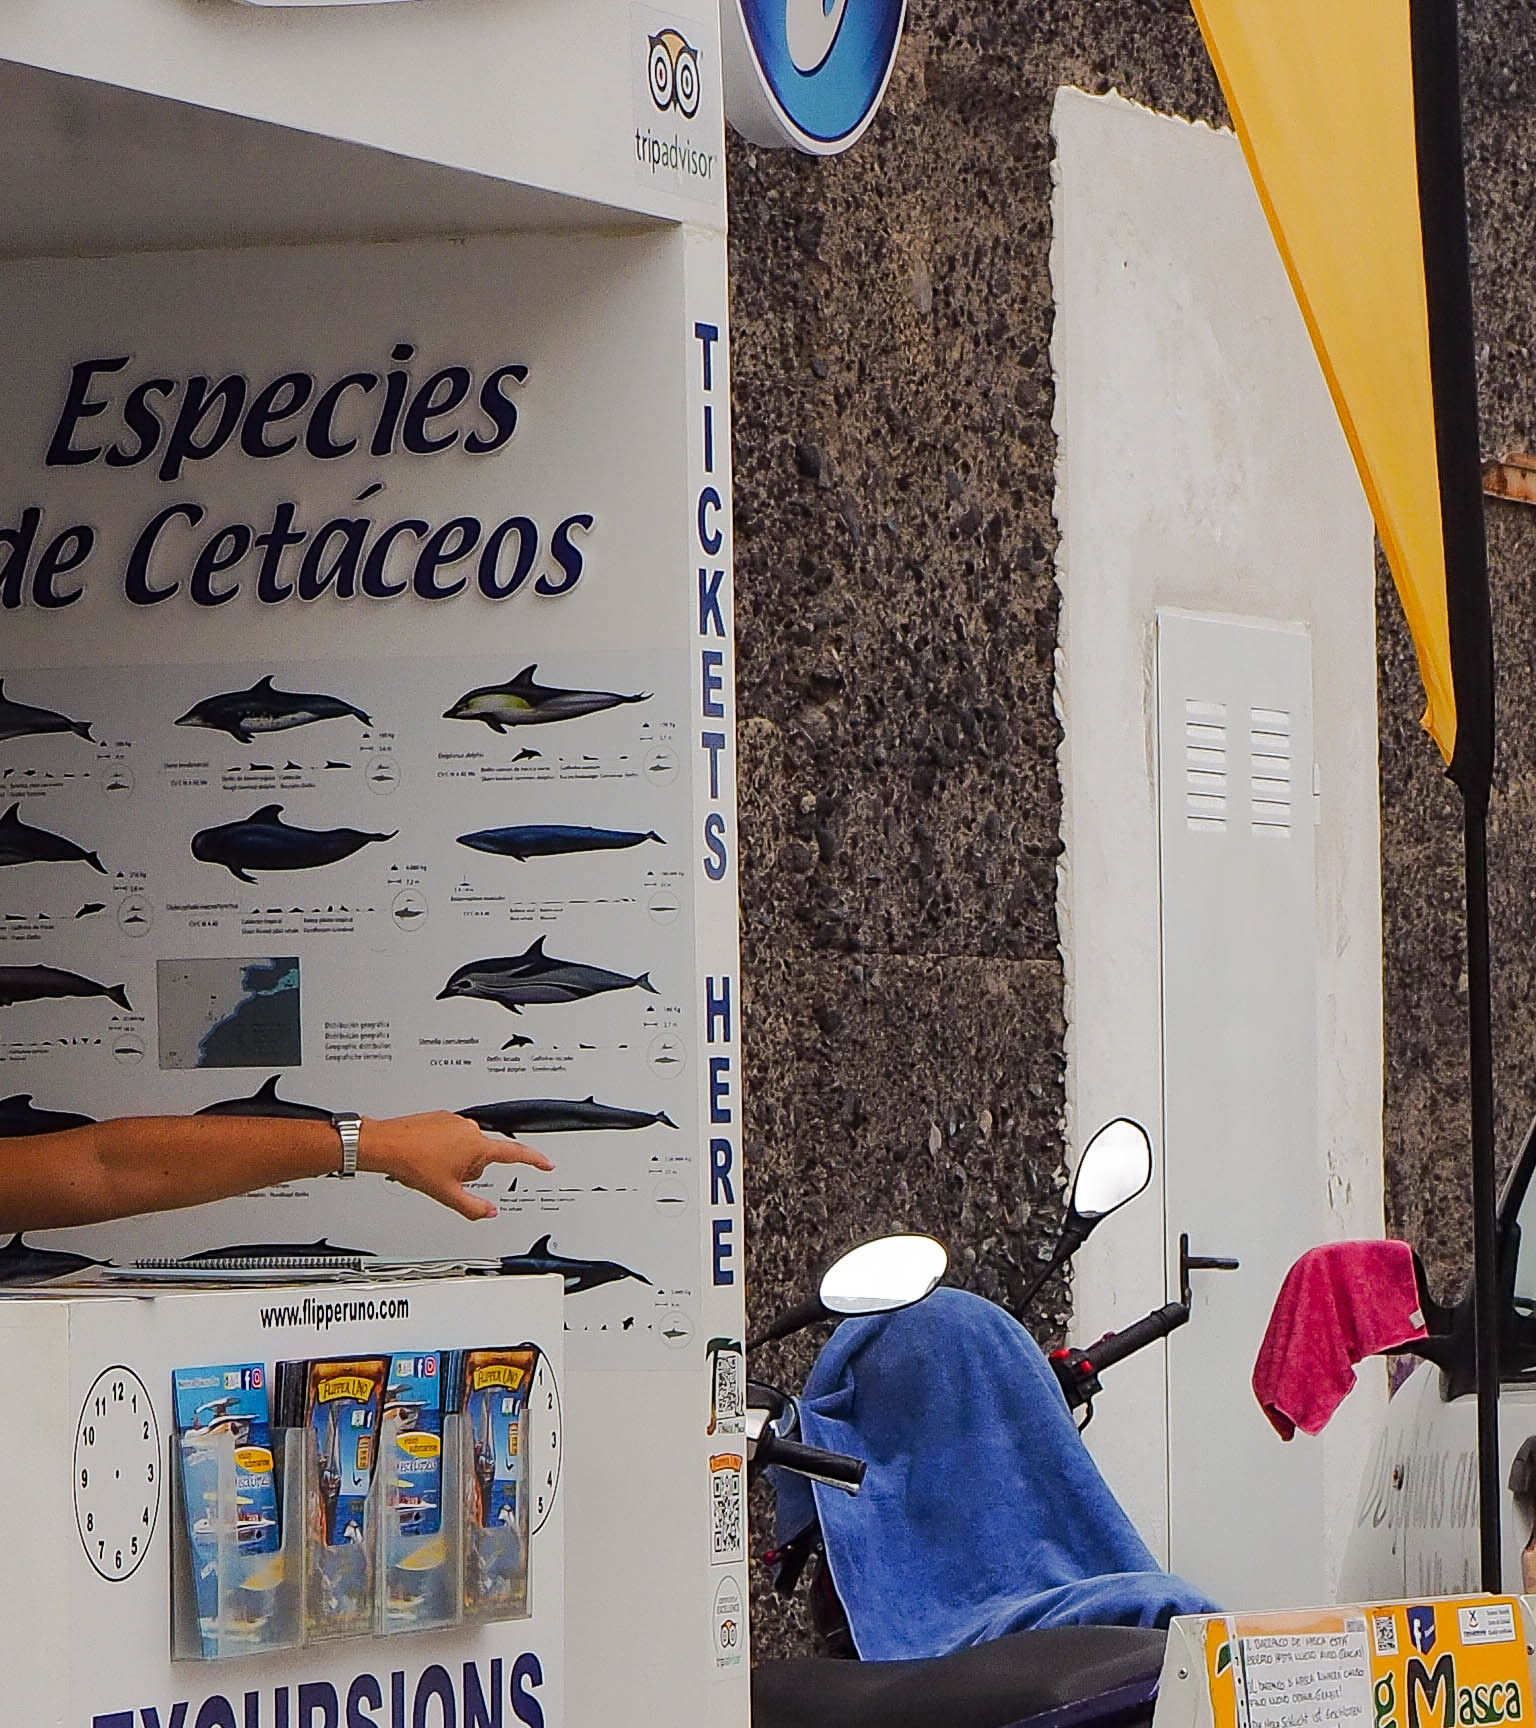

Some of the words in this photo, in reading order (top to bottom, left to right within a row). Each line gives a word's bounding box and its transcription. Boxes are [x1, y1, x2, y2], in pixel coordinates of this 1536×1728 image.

[635, 127, 714, 180] tripadvisor
[46, 344, 528, 481] Especies
[124, 484, 595, 606] Cetáceos
[693, 323, 728, 881] TICKETS
[704, 976, 735, 1287] HERE
[261, 1296, 409, 1331] www.flipperuno.com
[112, 1382, 125, 1402] 12
[96, 1398, 106, 1417] 11
[131, 1394, 138, 1414] 1
[83, 1426, 95, 1446] 10
[143, 1420, 150, 1440] 2
[81, 1469, 88, 1488] 9
[147, 1463, 154, 1483] 3
[86, 1512, 94, 1532] 8
[142, 1506, 150, 1526] 4
[98, 1541, 105, 1560] 7
[131, 1538, 138, 1557] 5
[115, 1550, 122, 1570] 6
